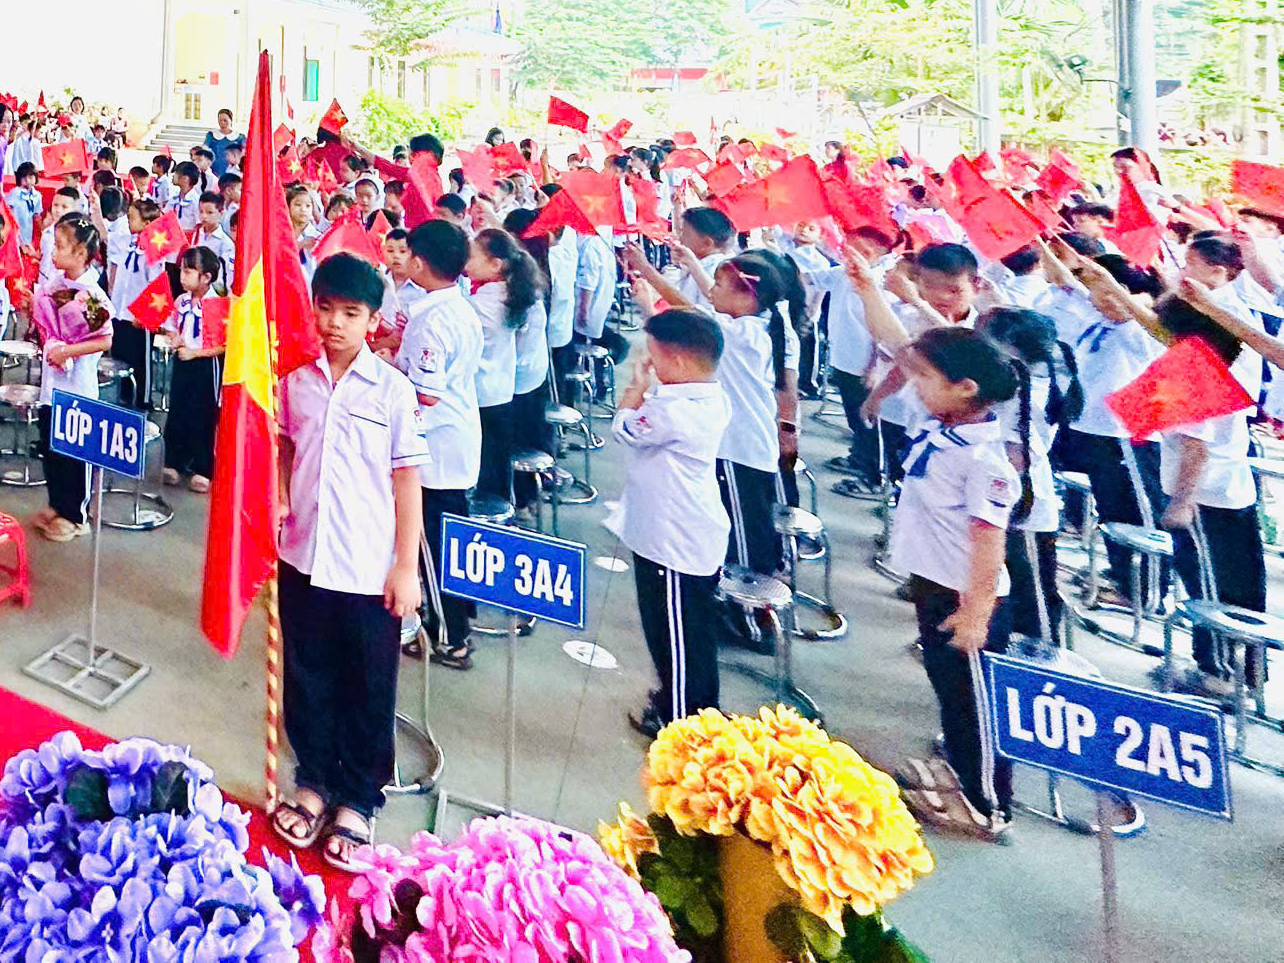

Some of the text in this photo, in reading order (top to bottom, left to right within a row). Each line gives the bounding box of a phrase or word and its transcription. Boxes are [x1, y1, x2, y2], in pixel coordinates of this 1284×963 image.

[54, 400, 138, 464] LỚP 1A3
[449, 532, 574, 607] LỚP 3A4
[1006, 682, 1214, 789] LỚP 2A5
